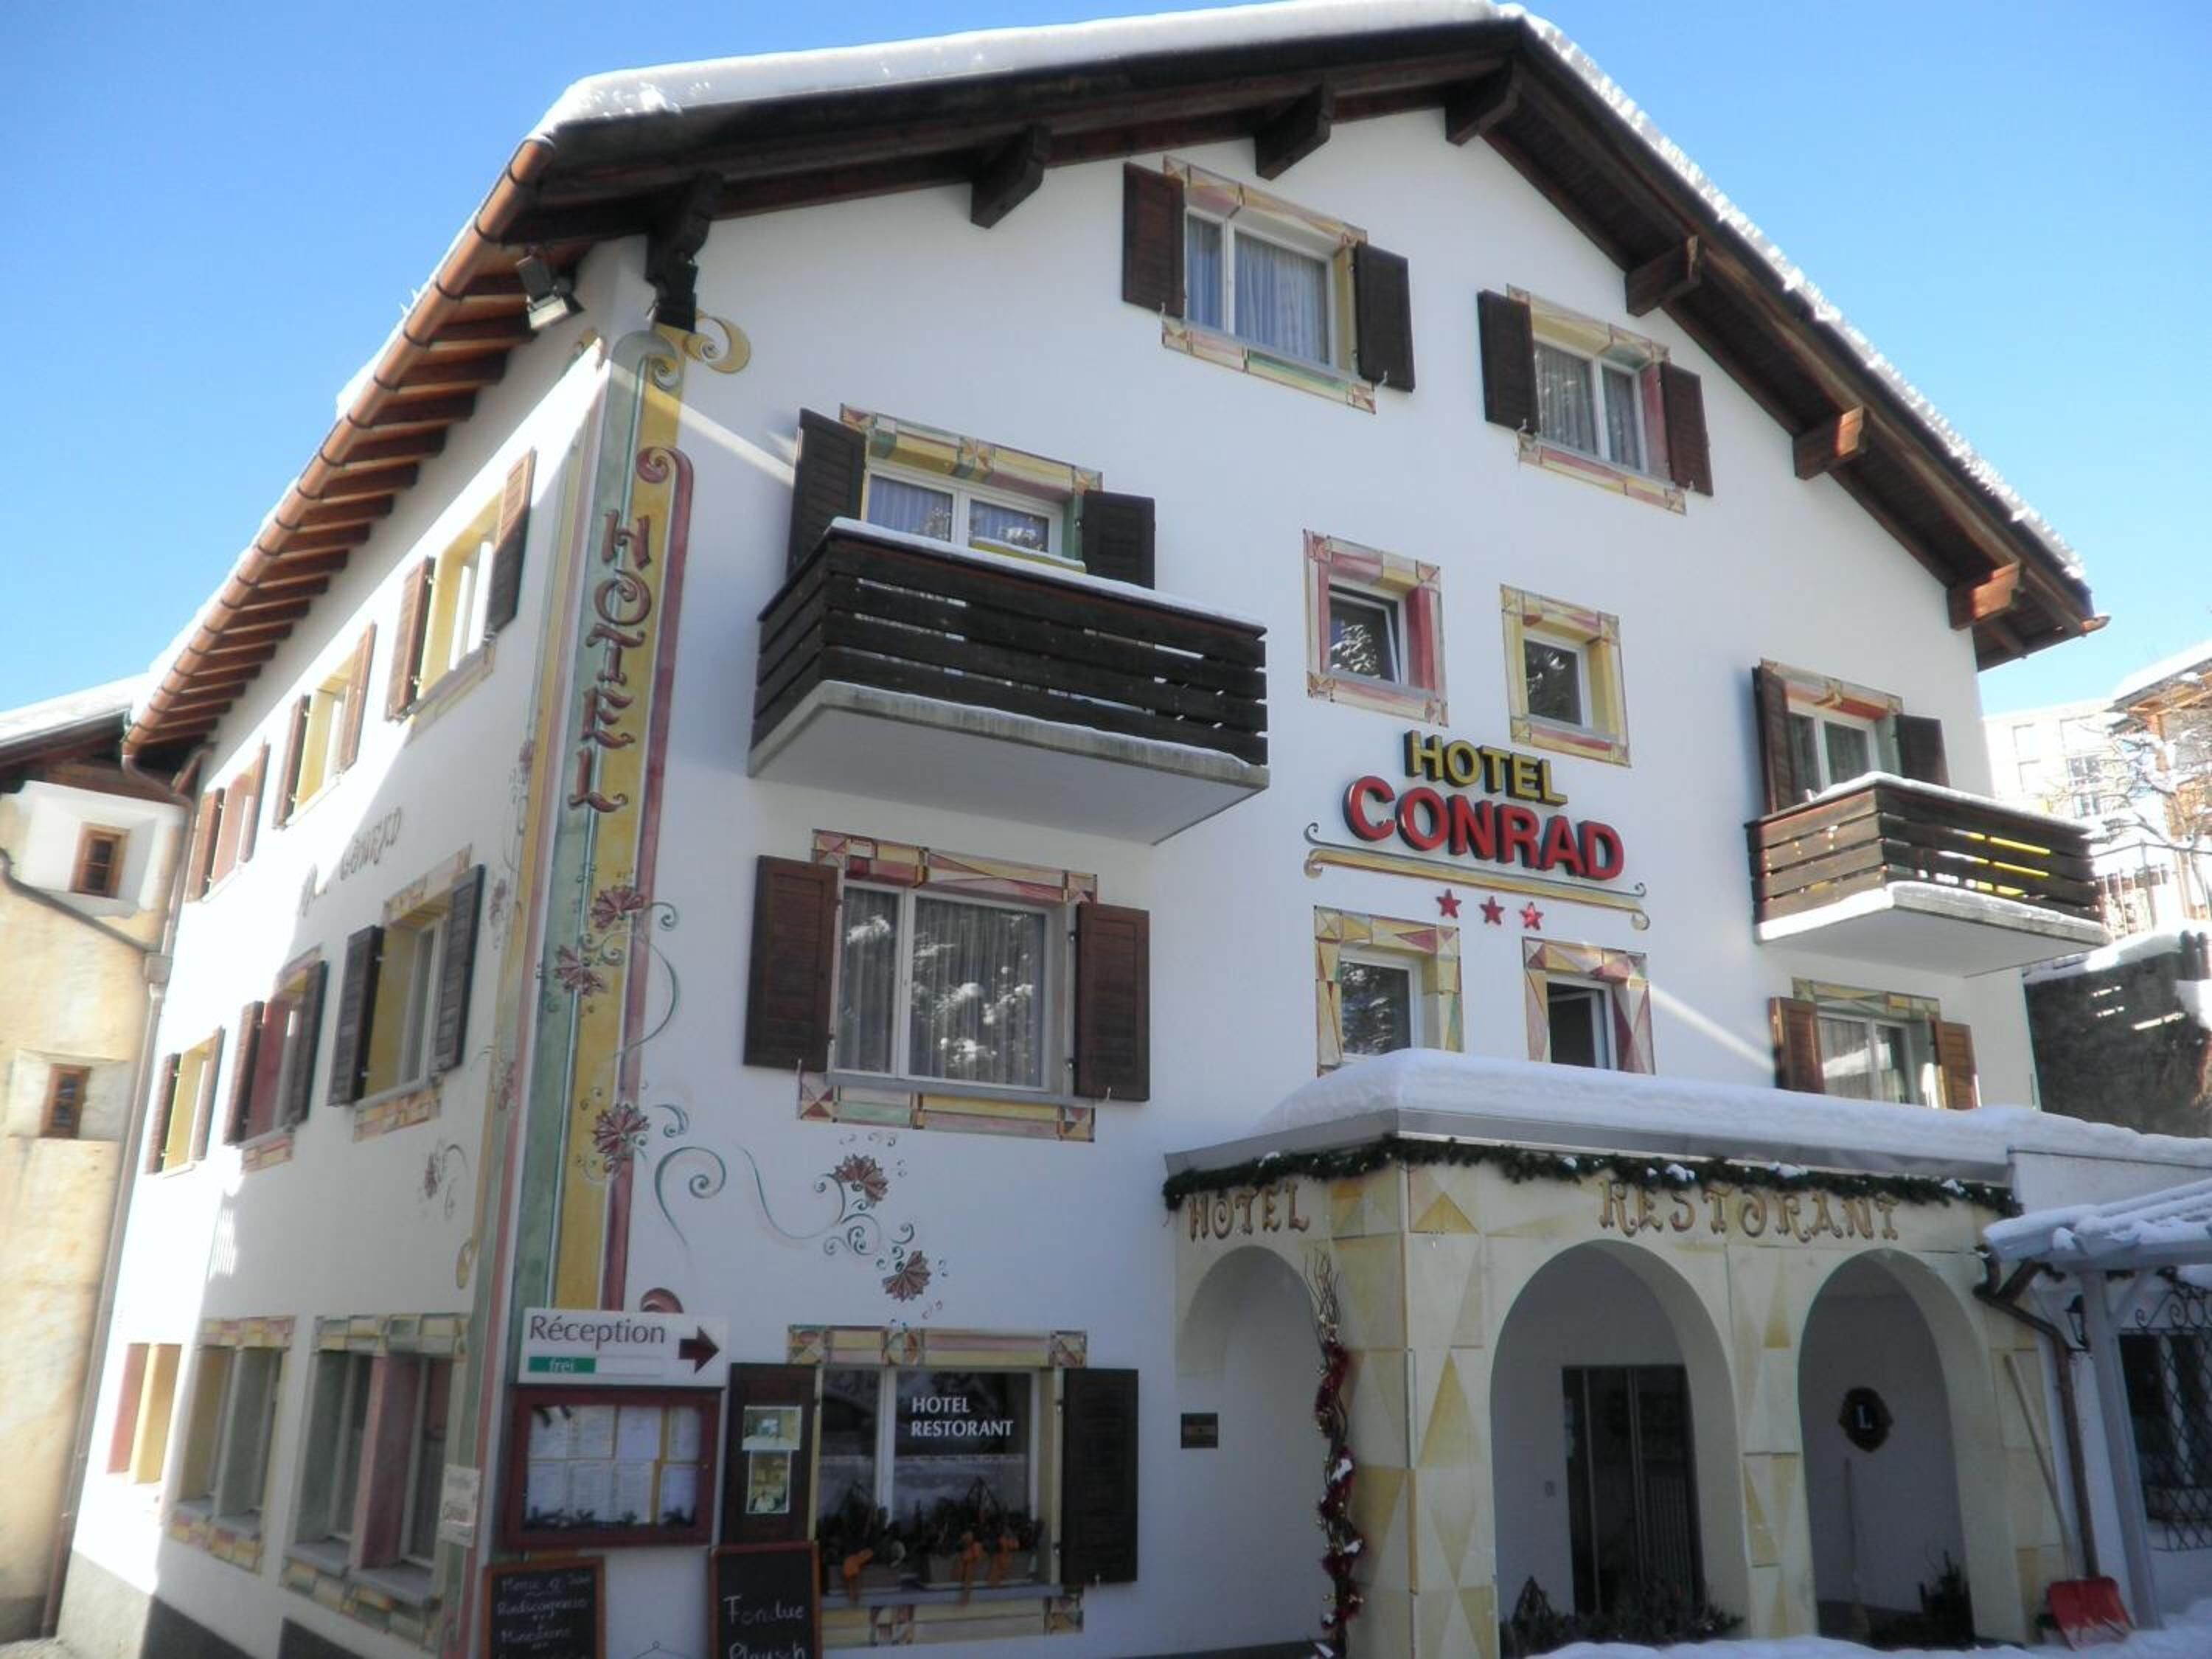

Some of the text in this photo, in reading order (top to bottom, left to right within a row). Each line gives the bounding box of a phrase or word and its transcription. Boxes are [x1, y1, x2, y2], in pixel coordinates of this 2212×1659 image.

[568, 509, 652, 812] HOTEL
[1405, 730, 1568, 806] HOTEL
[1343, 775, 1624, 880] CONRAD
[1189, 1181, 1310, 1242] HOTEL
[1599, 1179, 1900, 1243] RESTORANT
[529, 1315, 667, 1351] Réception
[549, 1357, 577, 1374] frei
[910, 1419, 1015, 1438] RESTORANT
[911, 1396, 972, 1414] HOTEL
[723, 1594, 805, 1626] Fondue
